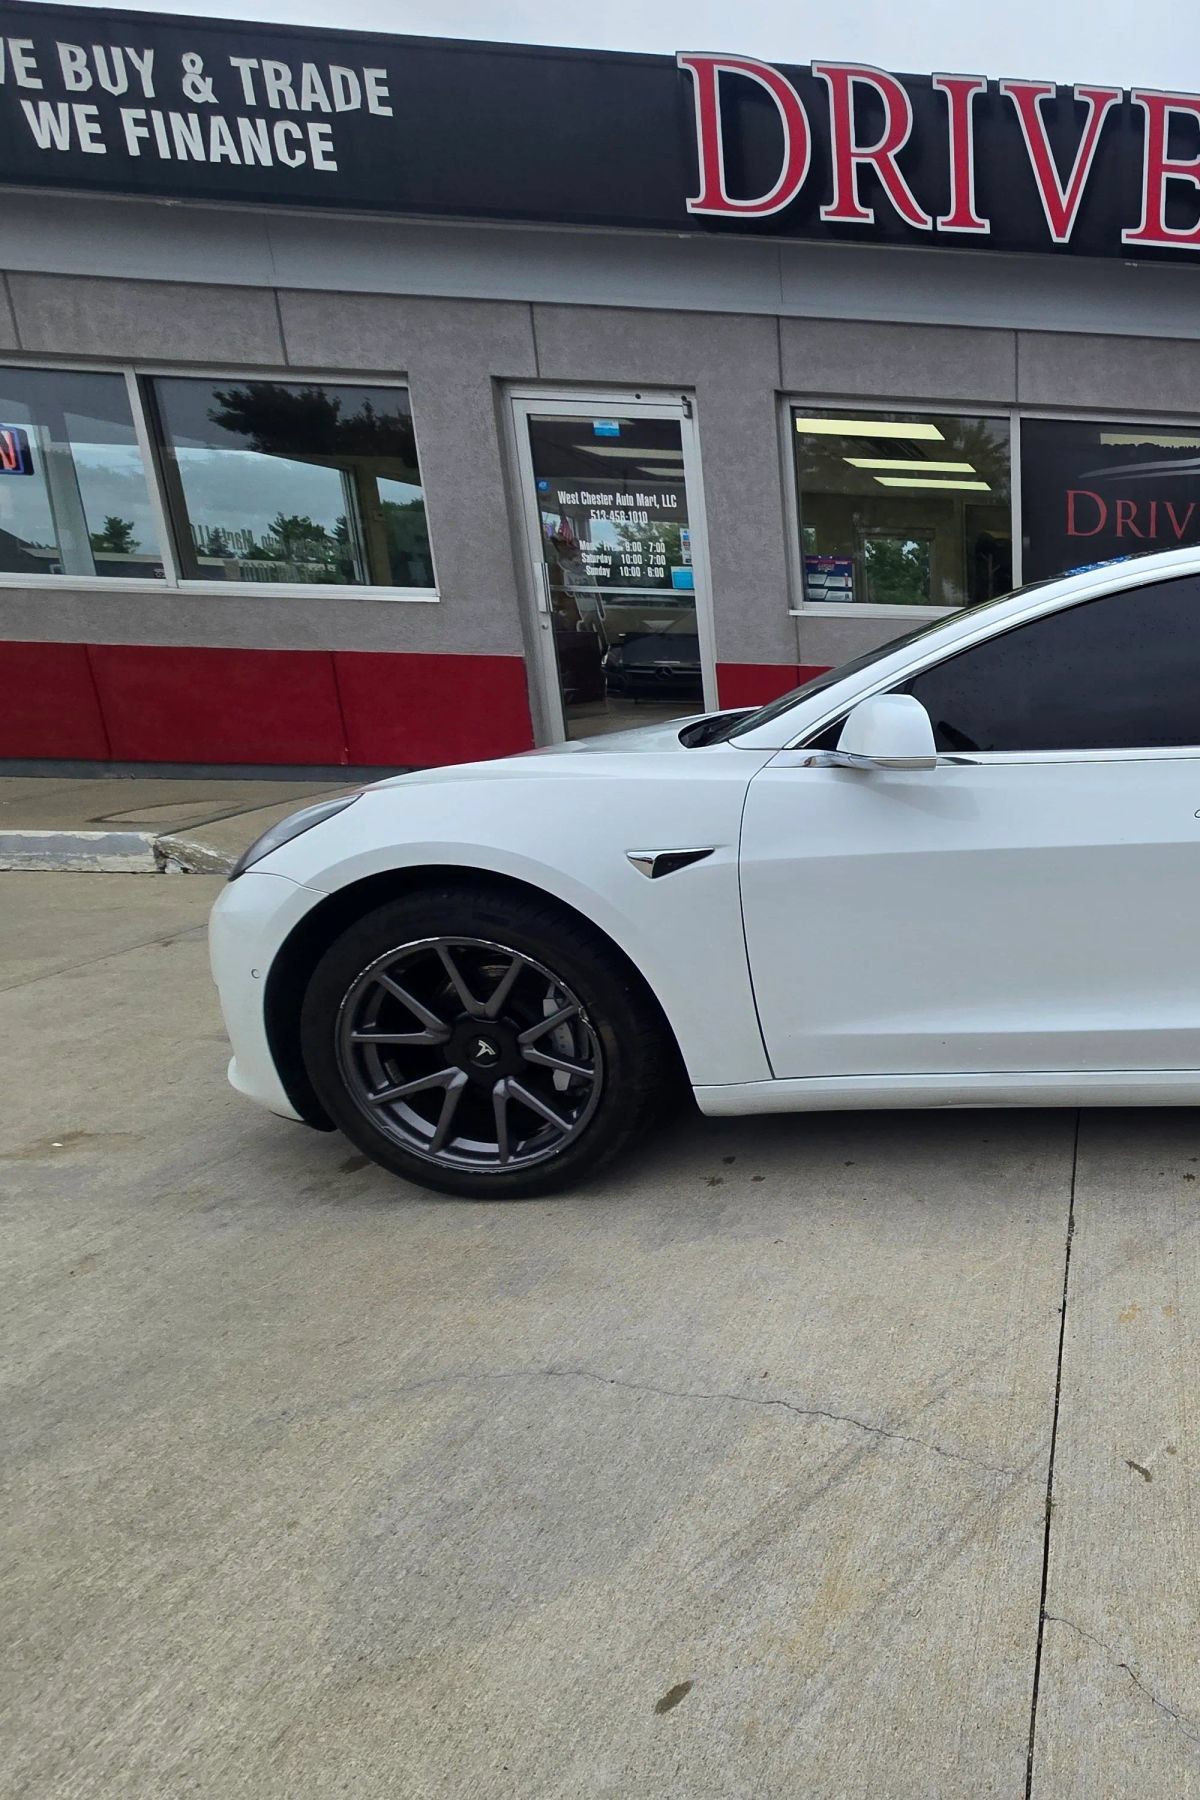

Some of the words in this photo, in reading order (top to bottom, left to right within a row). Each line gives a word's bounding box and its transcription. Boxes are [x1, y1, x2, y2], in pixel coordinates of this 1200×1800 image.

[0, 37, 44, 90] E
[56, 41, 154, 98] BUY
[181, 52, 219, 104] &
[229, 56, 393, 117] TRADE
[20, 100, 107, 154] WE
[120, 108, 338, 172] FINANCE
[557, 490, 580, 505] West
[580, 491, 613, 506] Chester
[616, 492, 634, 506] Auto
[635, 493, 660, 509] Mart,
[661, 494, 677, 508] LLC
[590, 509, 648, 524] 513-458-1010
[648, 542, 665, 553] 7:00
[581, 553, 612, 565] Saturday
[621, 554, 642, 565] 10:00
[648, 554, 666, 566] 7:00
[585, 565, 611, 578] Sunday
[620, 566, 641, 577] 10:00
[647, 566, 664, 578] 6:00
